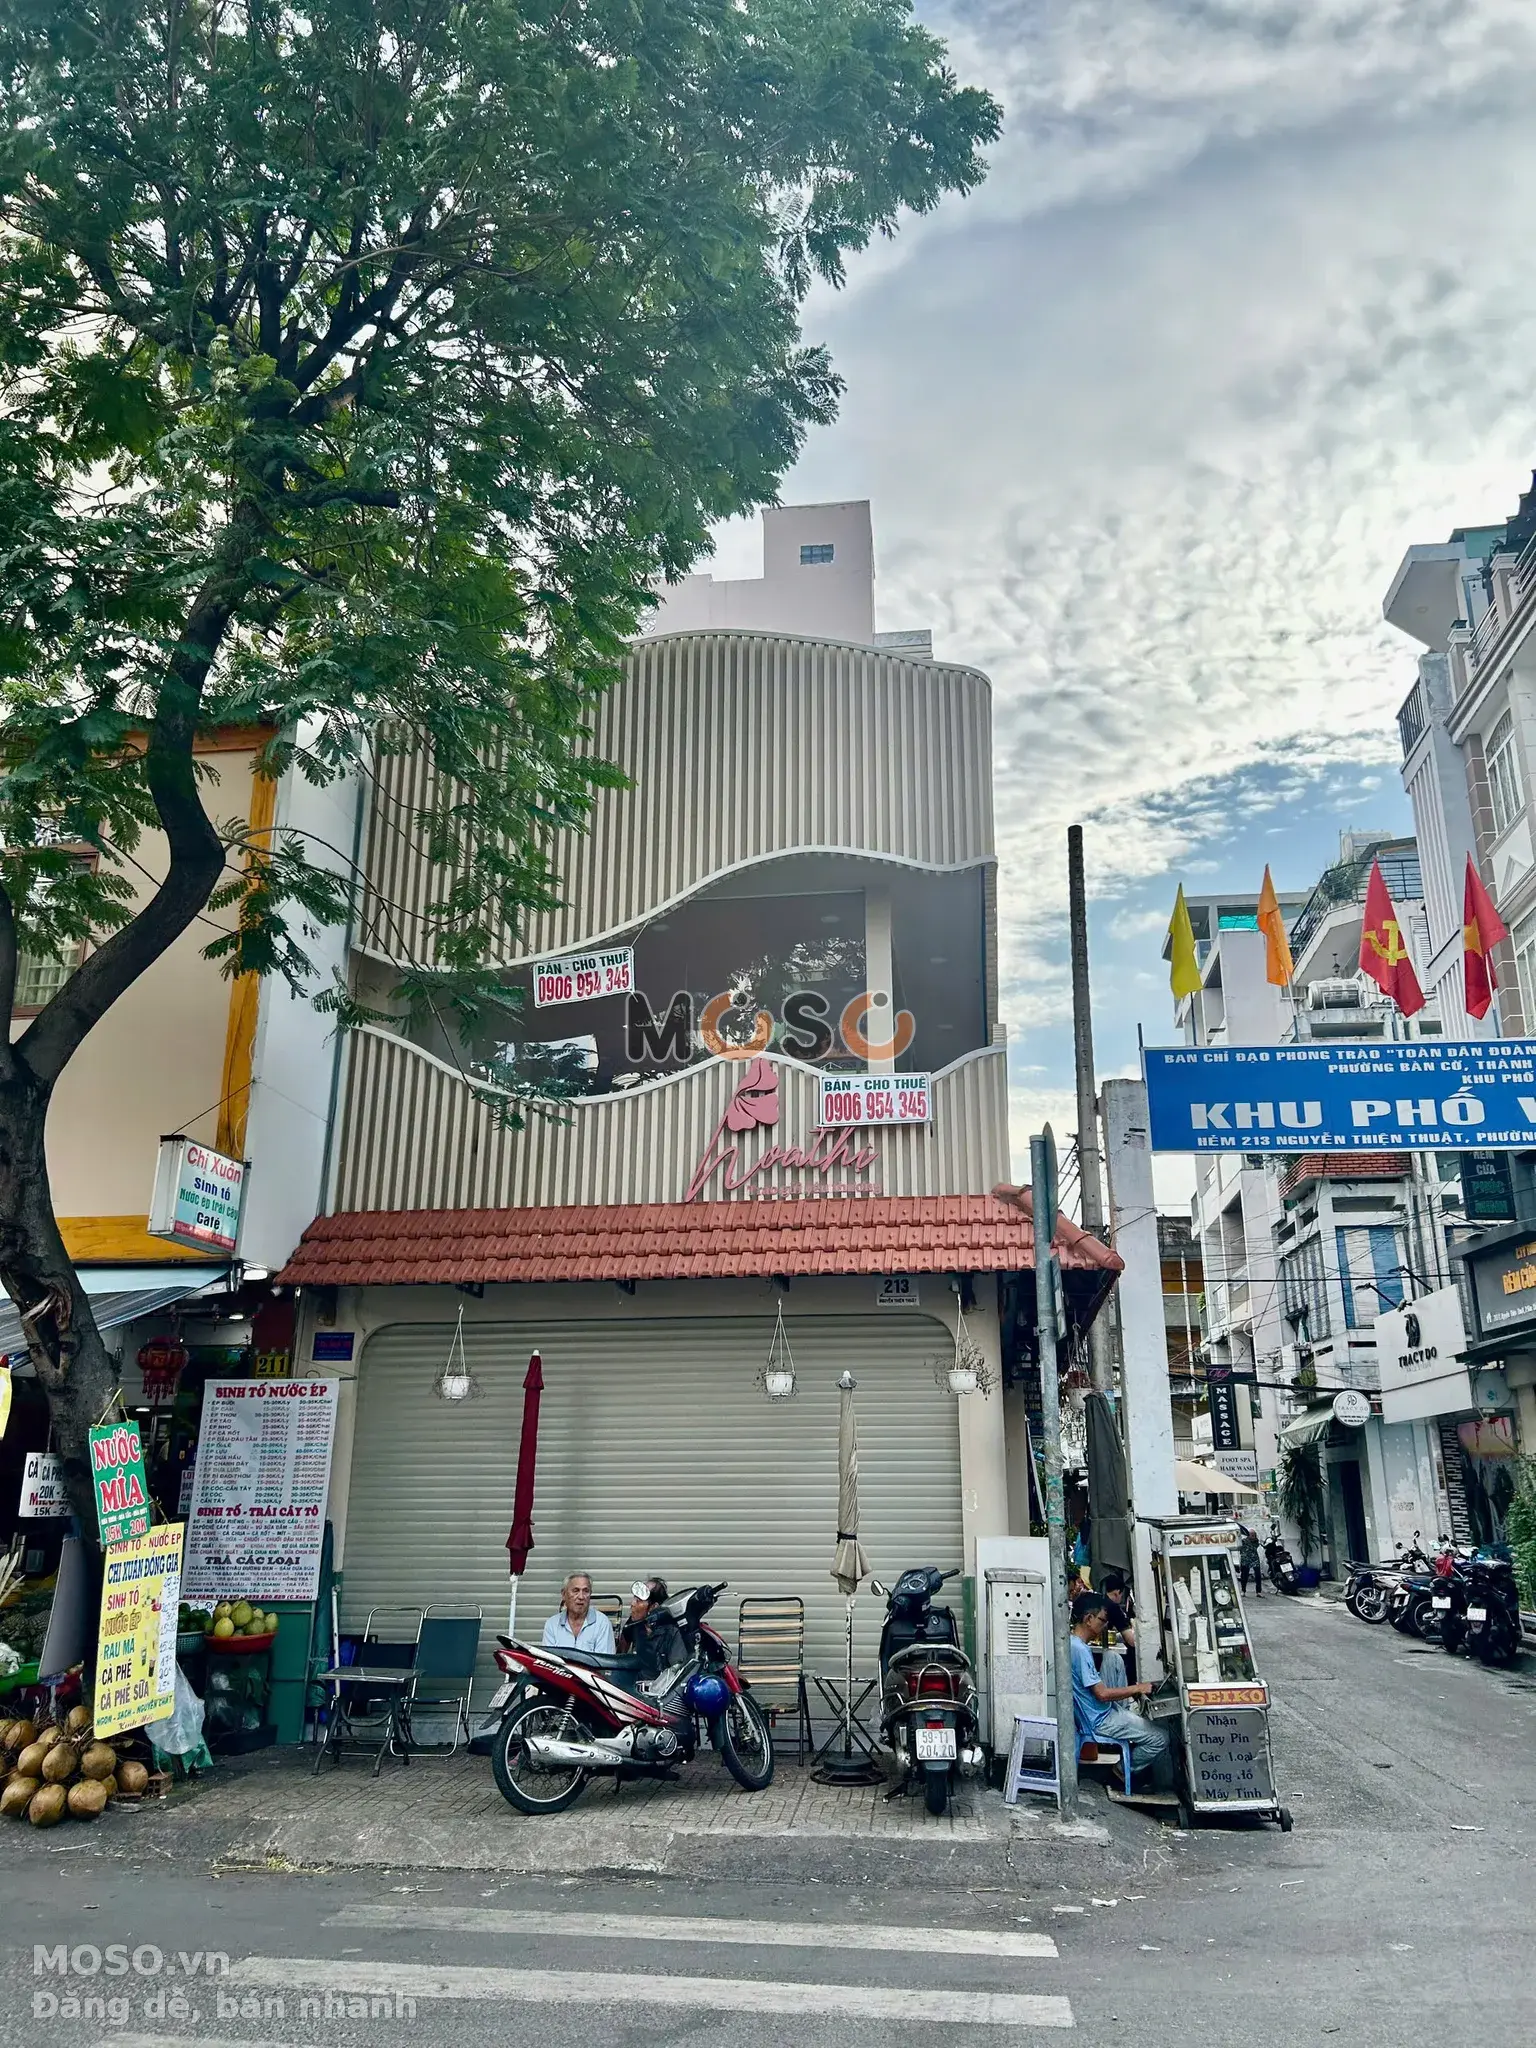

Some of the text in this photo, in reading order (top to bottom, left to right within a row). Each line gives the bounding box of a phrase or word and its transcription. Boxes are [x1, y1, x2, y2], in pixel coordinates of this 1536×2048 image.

[537, 951, 629, 975] BÁN CHO THUÊ
[538, 963, 630, 1003] 0906 954 345
[1164, 1054, 1198, 1064] BAN
[1235, 1052, 1270, 1064] ĐẠO
[1276, 1051, 1330, 1061] PHONG
[1336, 1047, 1380, 1060] TRÀO
[1447, 1046, 1483, 1057] DÂN
[1488, 1045, 1536, 1056] ĐOÀN
[1328, 1058, 1533, 1074] PHƯỜNG BÀN CỜ, THÀNH
[824, 1077, 927, 1092] BÁN CHO THUÊ
[1461, 1070, 1535, 1084] KHU PHỐ
[824, 1091, 927, 1122] 0906 954 345
[1190, 1101, 1323, 1130] KHU
[1350, 1086, 1486, 1127] PHỐ
[1197, 1134, 1236, 1147] HẺM
[1241, 1136, 1271, 1146] 213
[1276, 1131, 1346, 1145] NGUYỄN
[1352, 1132, 1403, 1146] THIỆN
[1408, 1131, 1470, 1146] THUẬT,
[187, 1146, 241, 1184] Chị Xuân
[196, 1211, 220, 1230] Café
[884, 1279, 909, 1293] 213
[259, 1357, 285, 1373] 211
[1398, 1350, 1424, 1368] TRACY
[1425, 1346, 1437, 1361] DO
[215, 1382, 327, 1398] SINH TỐ NƯỚC ÉP
[1216, 1387, 1232, 1445] MASSAGE
[93, 1426, 141, 1471] NƯỚC
[99, 1469, 145, 1514] MÍA
[197, 1507, 223, 1517] SINH
[225, 1503, 242, 1517] TỐ
[249, 1504, 277, 1517] TRÁI
[279, 1504, 303, 1517] CÂY
[109, 1541, 128, 1555] SINH
[205, 1554, 301, 1566] TRÀ CÁC LOẠI
[107, 1591, 127, 1611] SINH
[103, 1635, 135, 1660] RAU MÁ
[102, 1663, 113, 1685] CÀ
[100, 1688, 111, 1711] CÀ
[1189, 1690, 1264, 1705] SEIKO
[1206, 1715, 1238, 1727] Nhận
[1197, 1732, 1250, 1746] Thay Pin
[1199, 1751, 1221, 1762] Các
[1201, 1768, 1232, 1783] Đồng
[1205, 1789, 1229, 1800] Máy
